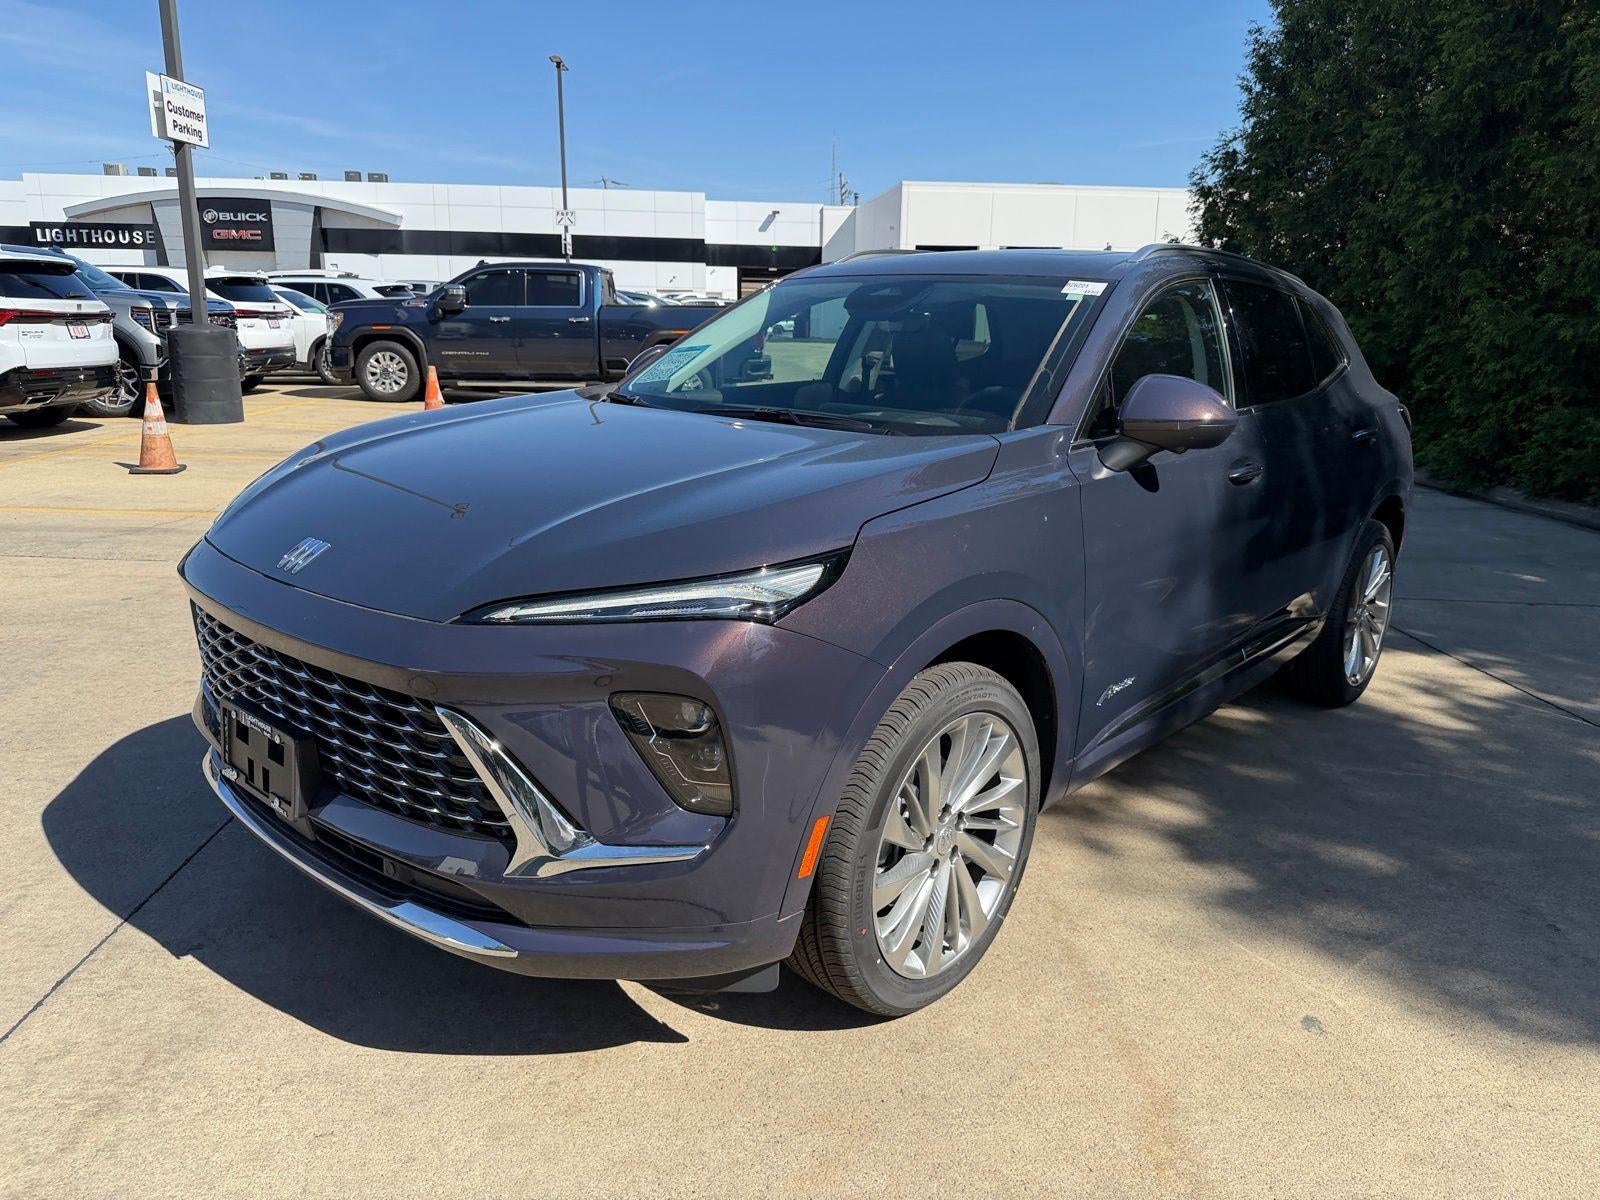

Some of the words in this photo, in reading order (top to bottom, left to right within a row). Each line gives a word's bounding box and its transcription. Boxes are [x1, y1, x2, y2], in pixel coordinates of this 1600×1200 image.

[171, 82, 204, 100] LIGHTHOUSE
[166, 100, 204, 123] Customer
[172, 119, 203, 142] Parking
[217, 211, 269, 222] BUICK
[36, 228, 156, 244] LIGHTHOUSE
[212, 229, 262, 241] GMC
